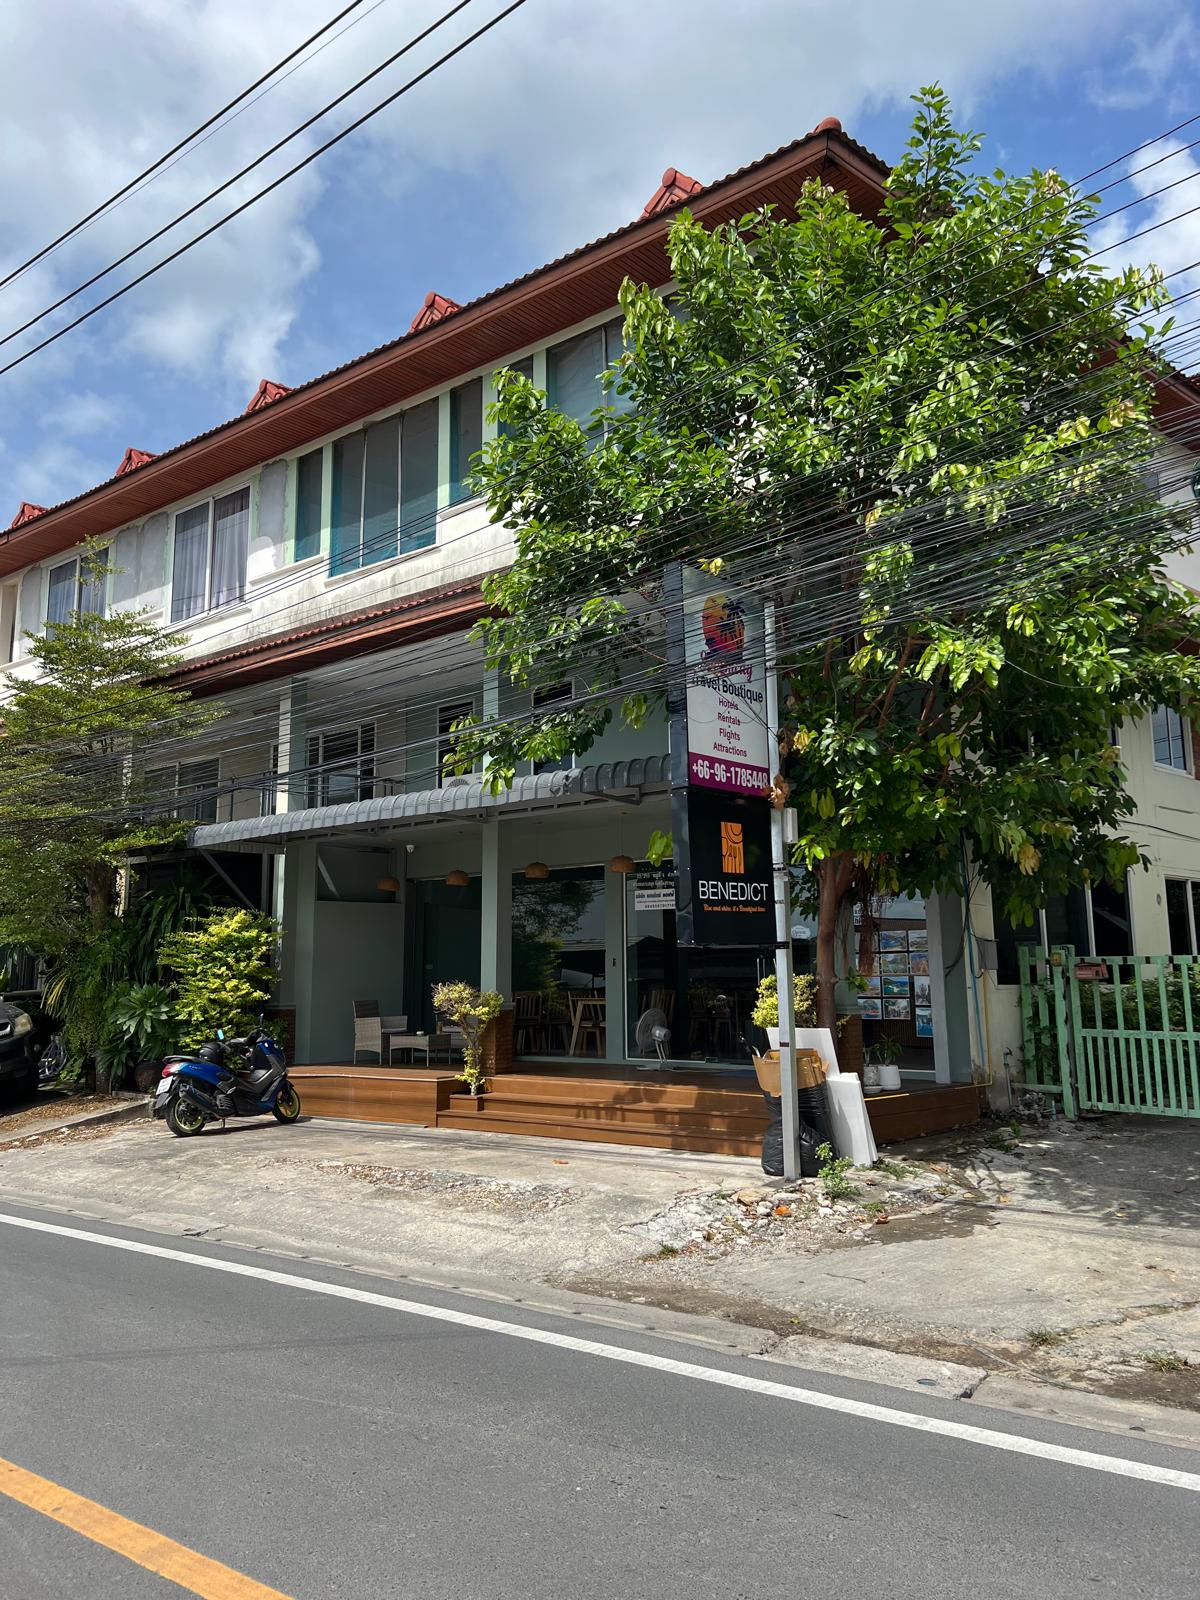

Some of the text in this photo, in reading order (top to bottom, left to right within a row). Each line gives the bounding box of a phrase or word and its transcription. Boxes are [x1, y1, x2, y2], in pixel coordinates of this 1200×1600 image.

[691, 674, 763, 704] ravel Boutique
[718, 698, 739, 711] Hotels
[718, 712, 741, 726] Rentals
[719, 728, 741, 741] Flights
[713, 742, 747, 757] Attractions
[692, 759, 768, 789] +66-96-1785448
[698, 880, 769, 901] BENEDICT
